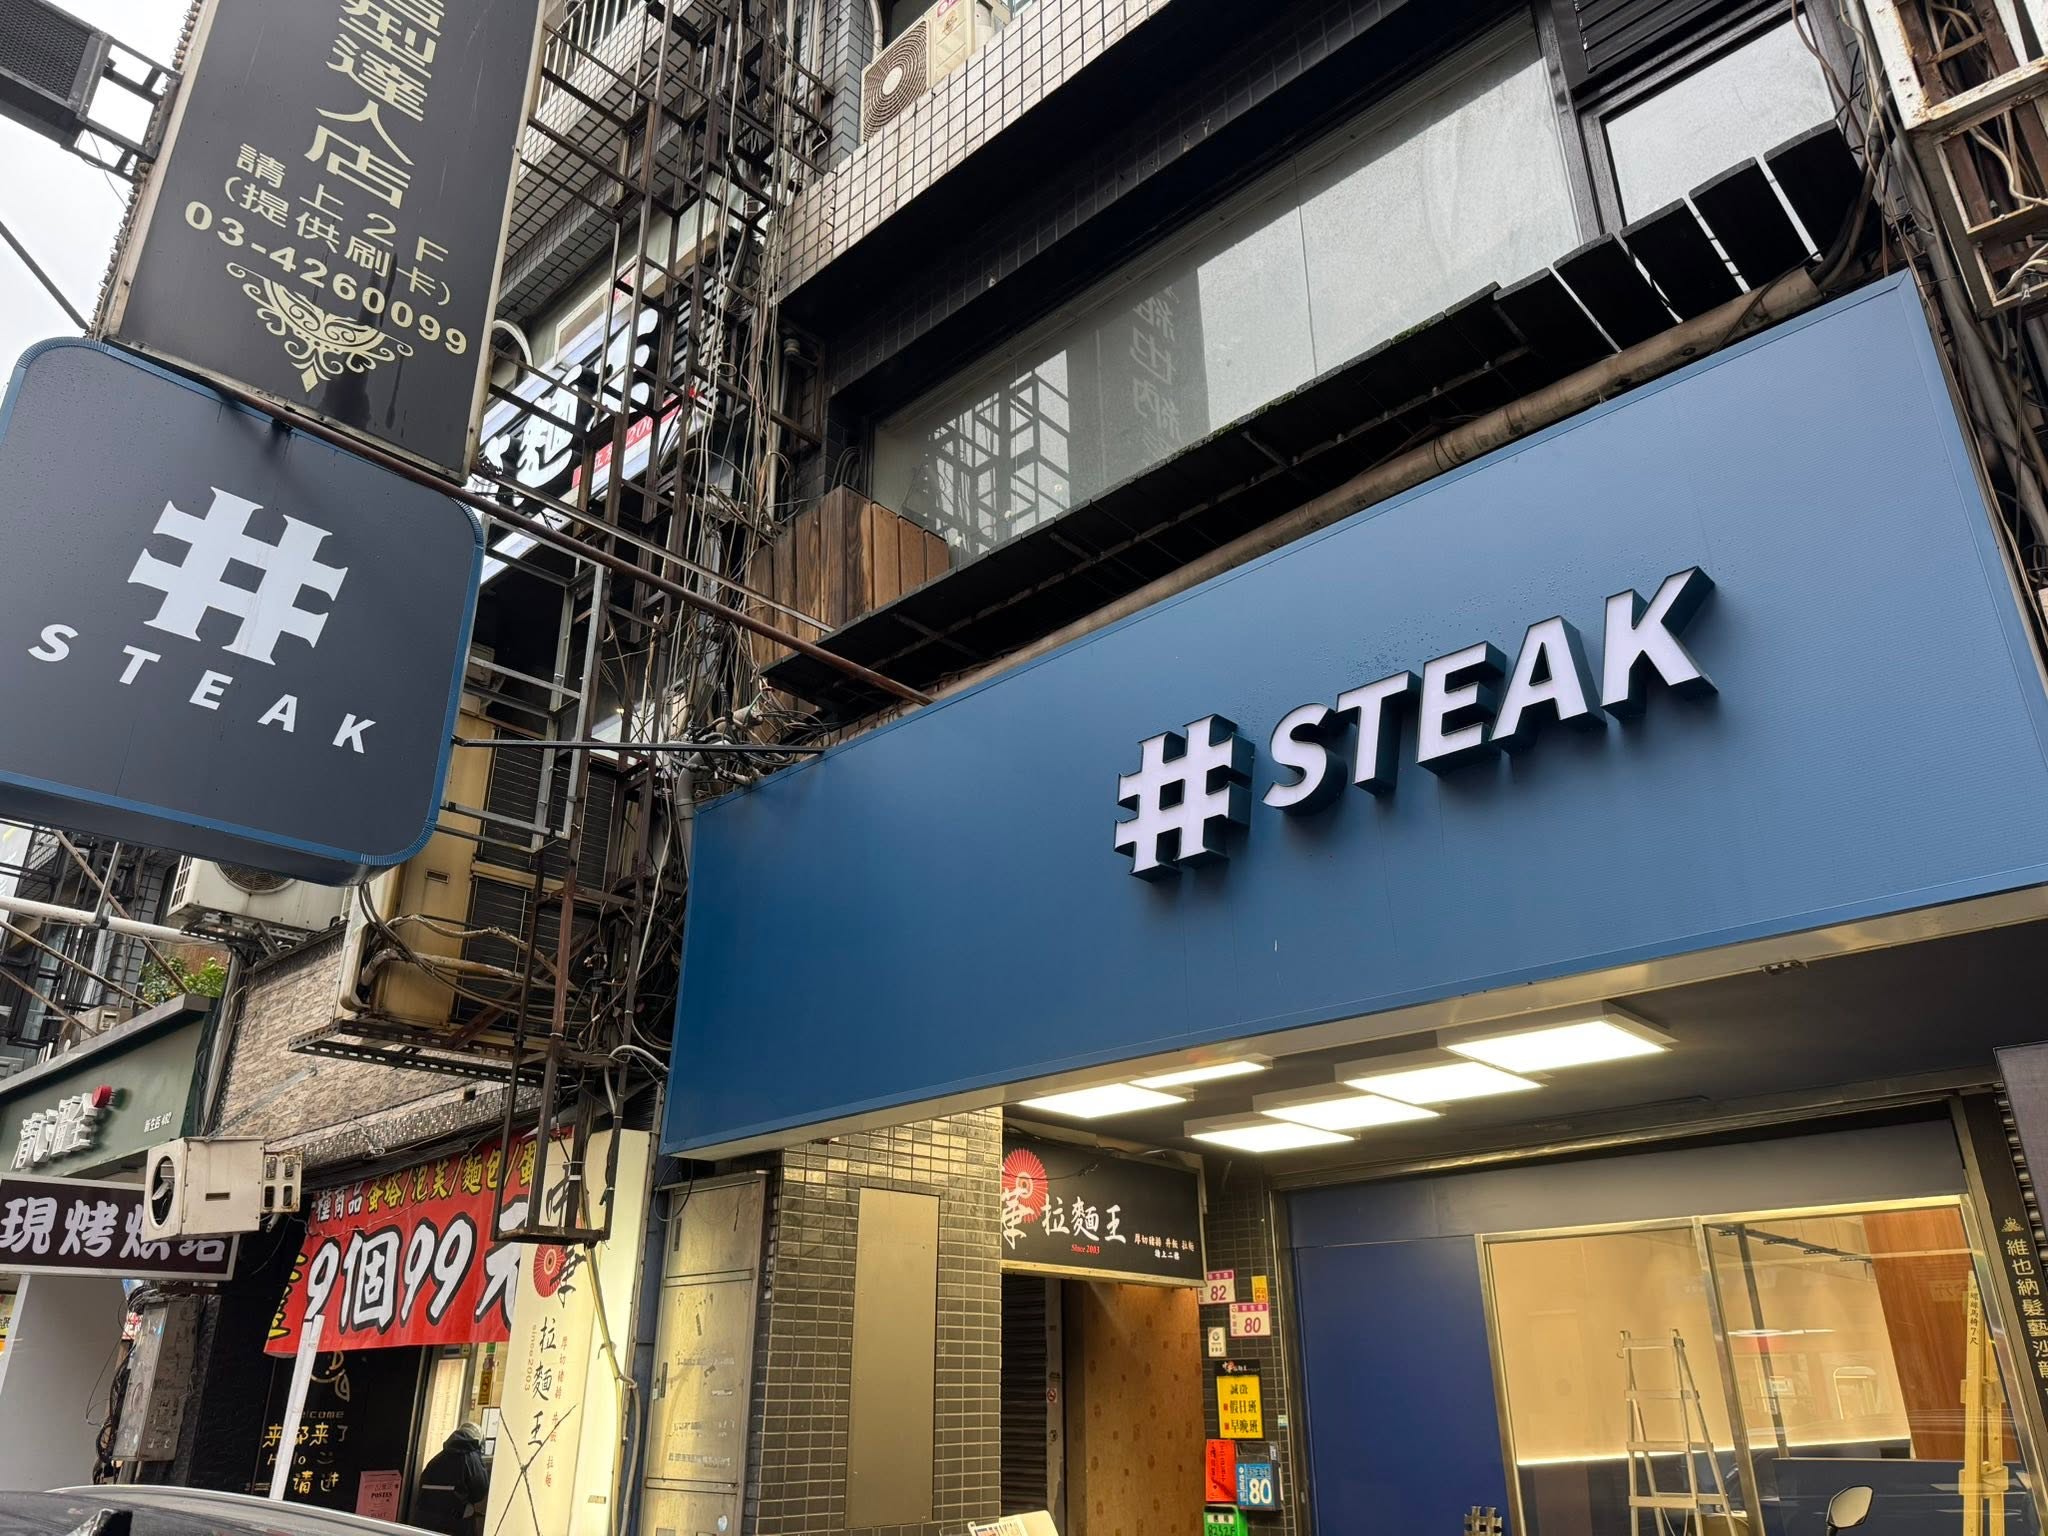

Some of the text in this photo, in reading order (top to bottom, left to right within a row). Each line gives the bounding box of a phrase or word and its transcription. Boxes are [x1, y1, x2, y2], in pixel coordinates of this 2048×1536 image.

[185, 201, 467, 355] 03-4260099
[27, 623, 377, 754] STEAK
[1071, 1243, 1086, 1254] Since
[1210, 1284, 1227, 1301] 82
[1244, 1316, 1261, 1334] 80
[1249, 1477, 1272, 1504] 80
